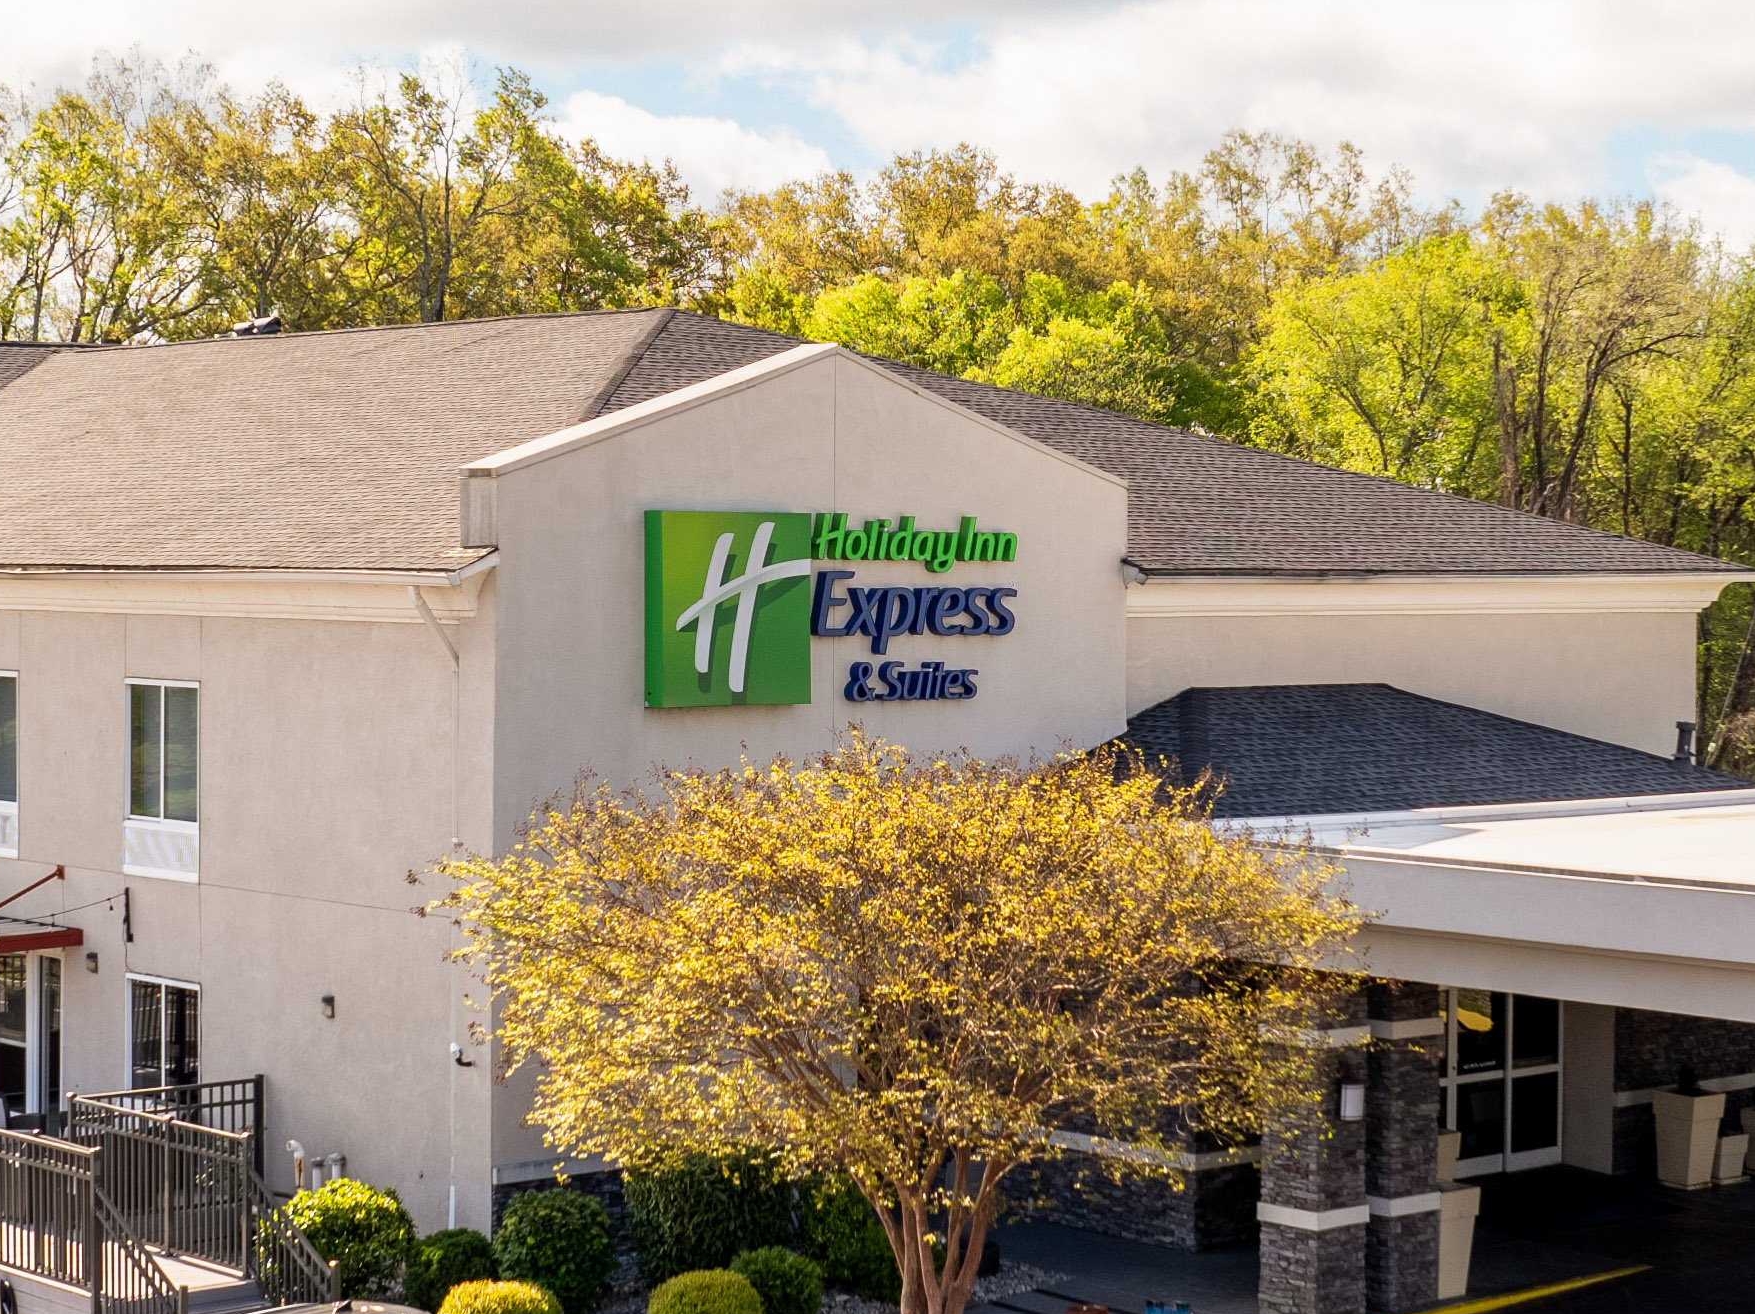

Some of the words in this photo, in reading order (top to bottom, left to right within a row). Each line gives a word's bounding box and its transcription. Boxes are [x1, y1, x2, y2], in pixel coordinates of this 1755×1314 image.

[812, 512, 960, 573] Holiday
[960, 515, 1018, 562] Inn
[811, 571, 1018, 655] Express
[845, 662, 875, 702] &
[878, 661, 979, 701] Suites
